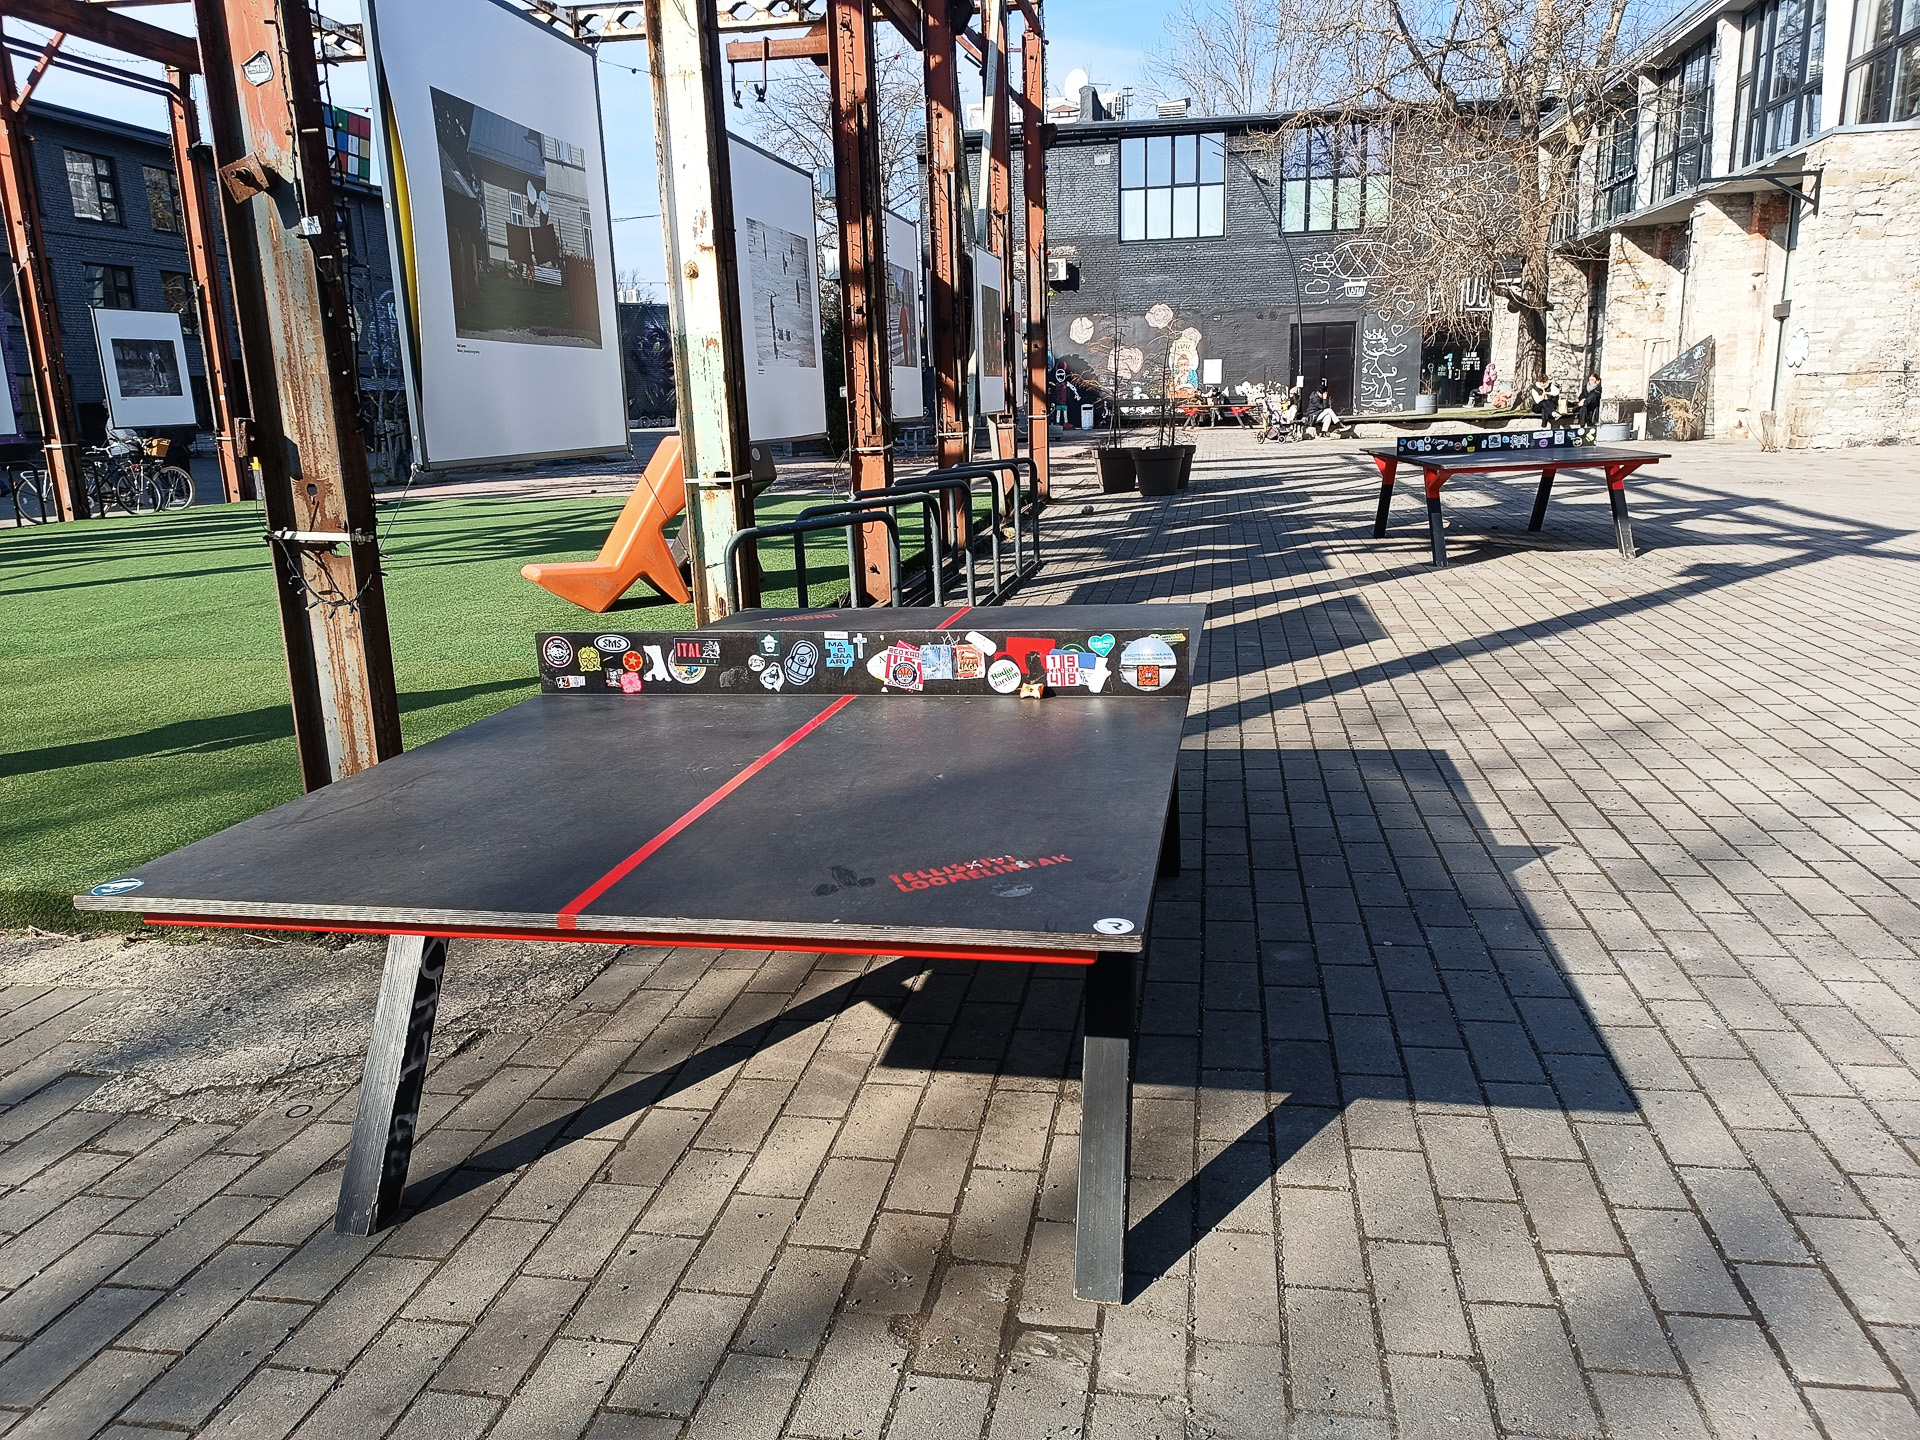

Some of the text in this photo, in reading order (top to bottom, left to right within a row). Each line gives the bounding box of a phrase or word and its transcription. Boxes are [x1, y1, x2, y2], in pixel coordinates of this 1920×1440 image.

[603, 639, 622, 647] SMS
[676, 642, 701, 658] ITAL
[905, 650, 921, 659] KAO
